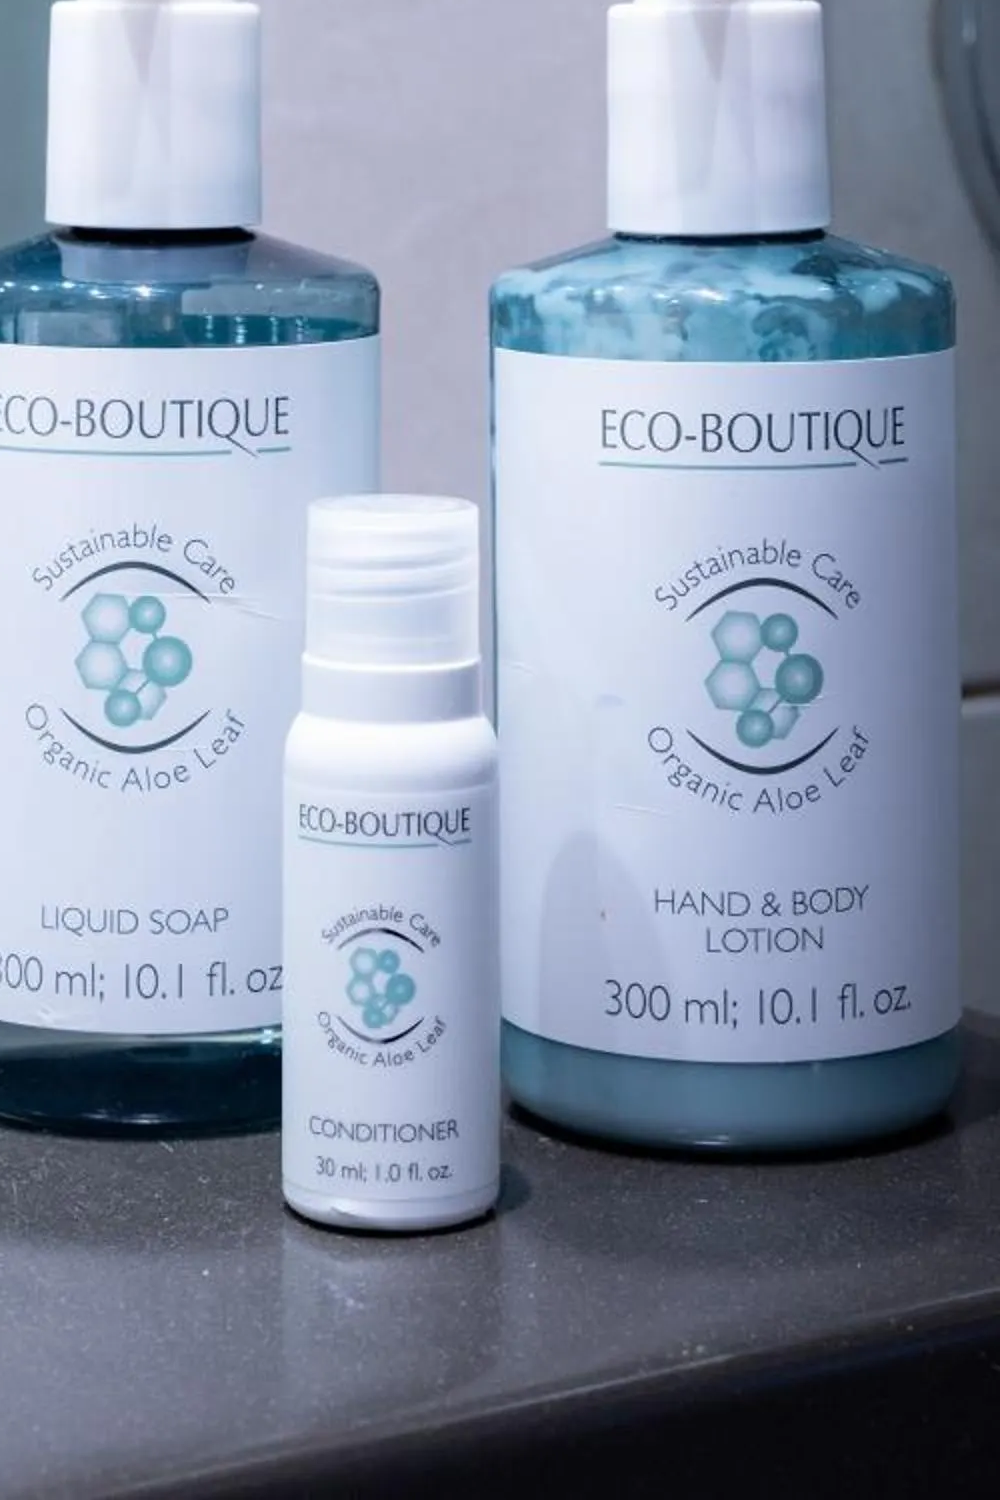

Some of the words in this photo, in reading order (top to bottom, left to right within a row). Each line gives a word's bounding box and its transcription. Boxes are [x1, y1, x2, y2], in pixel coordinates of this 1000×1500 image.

[601, 406, 905, 468] ECO-BOUTIQUE
[32, 524, 173, 592] Sustainable
[183, 537, 236, 595] Care
[655, 539, 801, 611] Sustainable
[811, 551, 861, 609] Care
[25, 702, 112, 791] Organic
[122, 764, 191, 793] Aloe
[195, 710, 246, 770] Leaf
[647, 726, 743, 813] Organic
[753, 781, 821, 813] Aloe
[822, 726, 871, 787] Leaf
[299, 803, 472, 845] ECO-BOUTIQUE
[41, 906, 139, 938] LIQUID
[149, 907, 230, 935] SOAP
[654, 889, 751, 917] HAND
[760, 892, 781, 917] &
[791, 884, 870, 915] BODY
[321, 904, 403, 947] Sustainable
[409, 913, 442, 948] Care
[706, 927, 824, 954] LOTION
[53, 962, 106, 1003] ml;
[122, 964, 186, 1000] 10.1
[206, 960, 236, 996] fl.
[604, 980, 671, 1022] 300
[684, 987, 738, 1029] ml;
[757, 988, 818, 1026] 10.1
[838, 984, 866, 1018] fl.
[874, 985, 911, 1015] oz.
[317, 1011, 369, 1066] Organic
[373, 1049, 415, 1068] Aloe
[417, 1016, 448, 1054] Leaf
[309, 1115, 459, 1143] CONDITIONER
[314, 1155, 336, 1179] 30
[341, 1160, 368, 1184] ml;
[374, 1161, 401, 1182] 1.0
[408, 1160, 424, 1181] fl.
[427, 1164, 453, 1181] oz.
